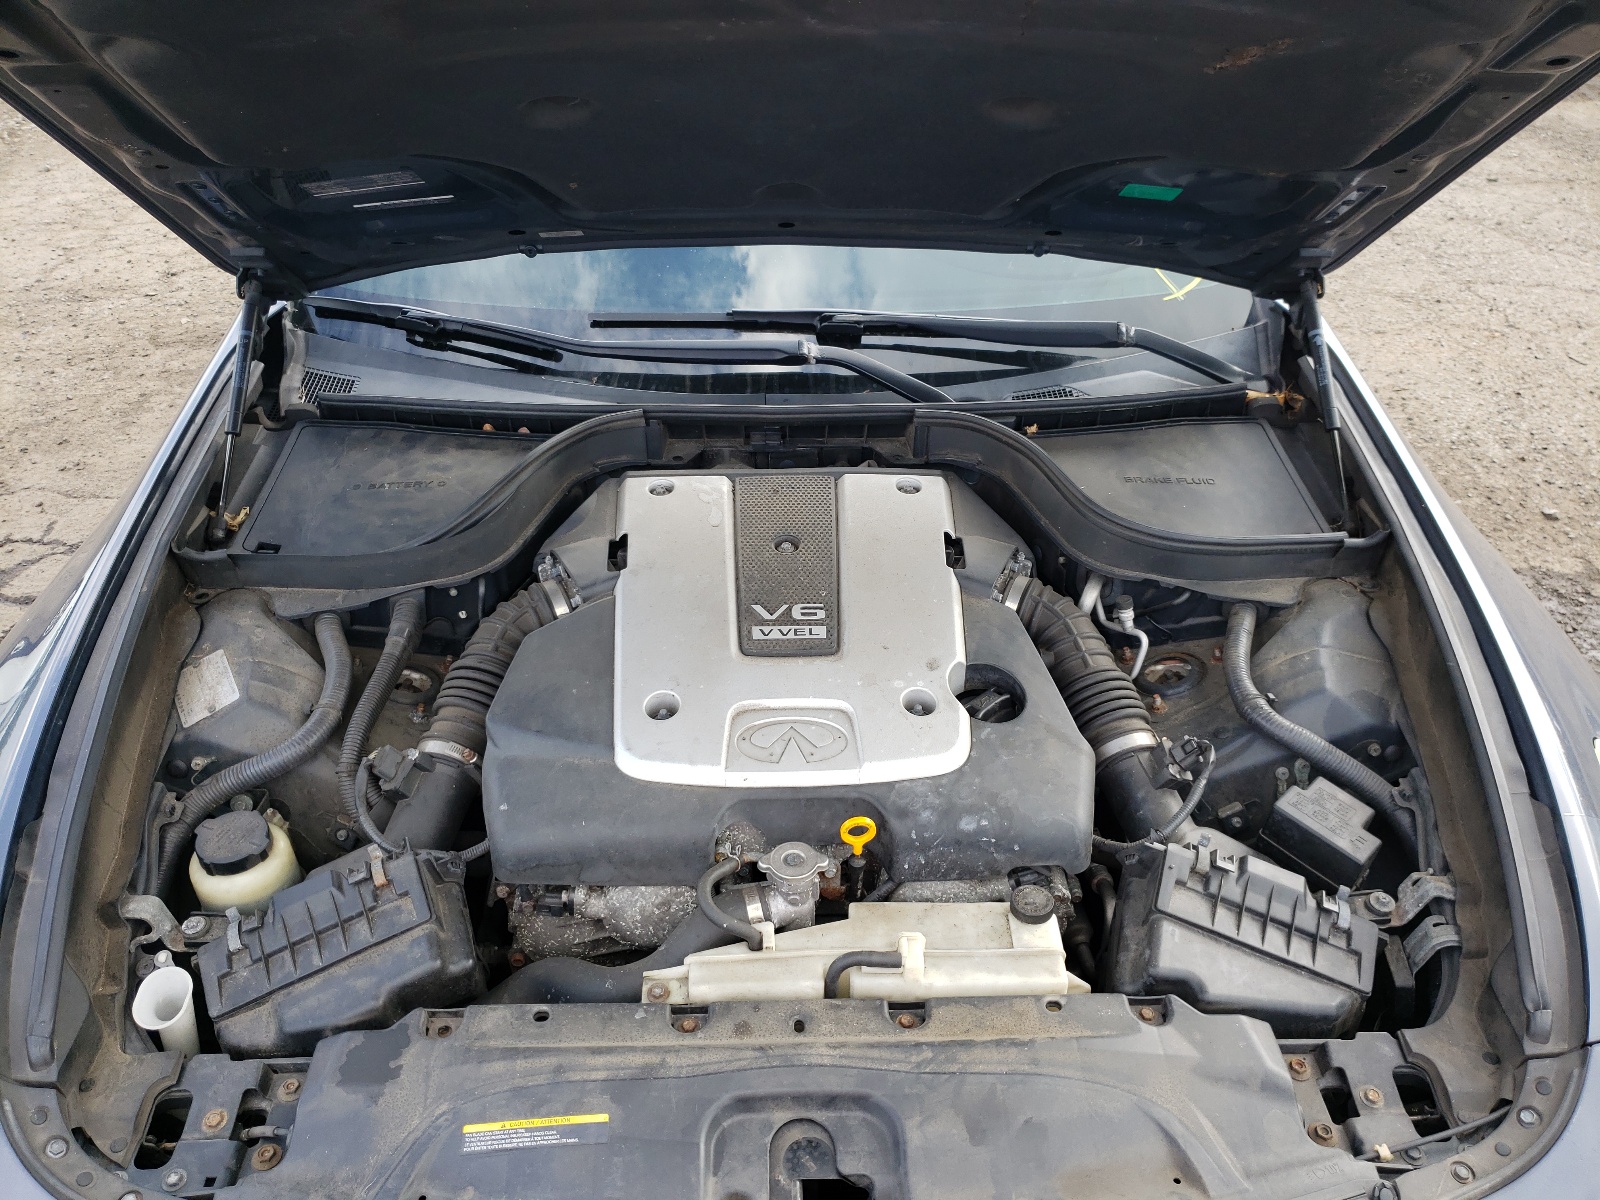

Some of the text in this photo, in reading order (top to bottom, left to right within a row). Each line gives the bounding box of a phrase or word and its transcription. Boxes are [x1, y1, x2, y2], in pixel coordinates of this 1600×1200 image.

[368, 480, 434, 490] BATTERY
[1123, 476, 1216, 485] BRAKE FLUID
[750, 603, 826, 620] V6
[758, 628, 820, 637] VVEL
